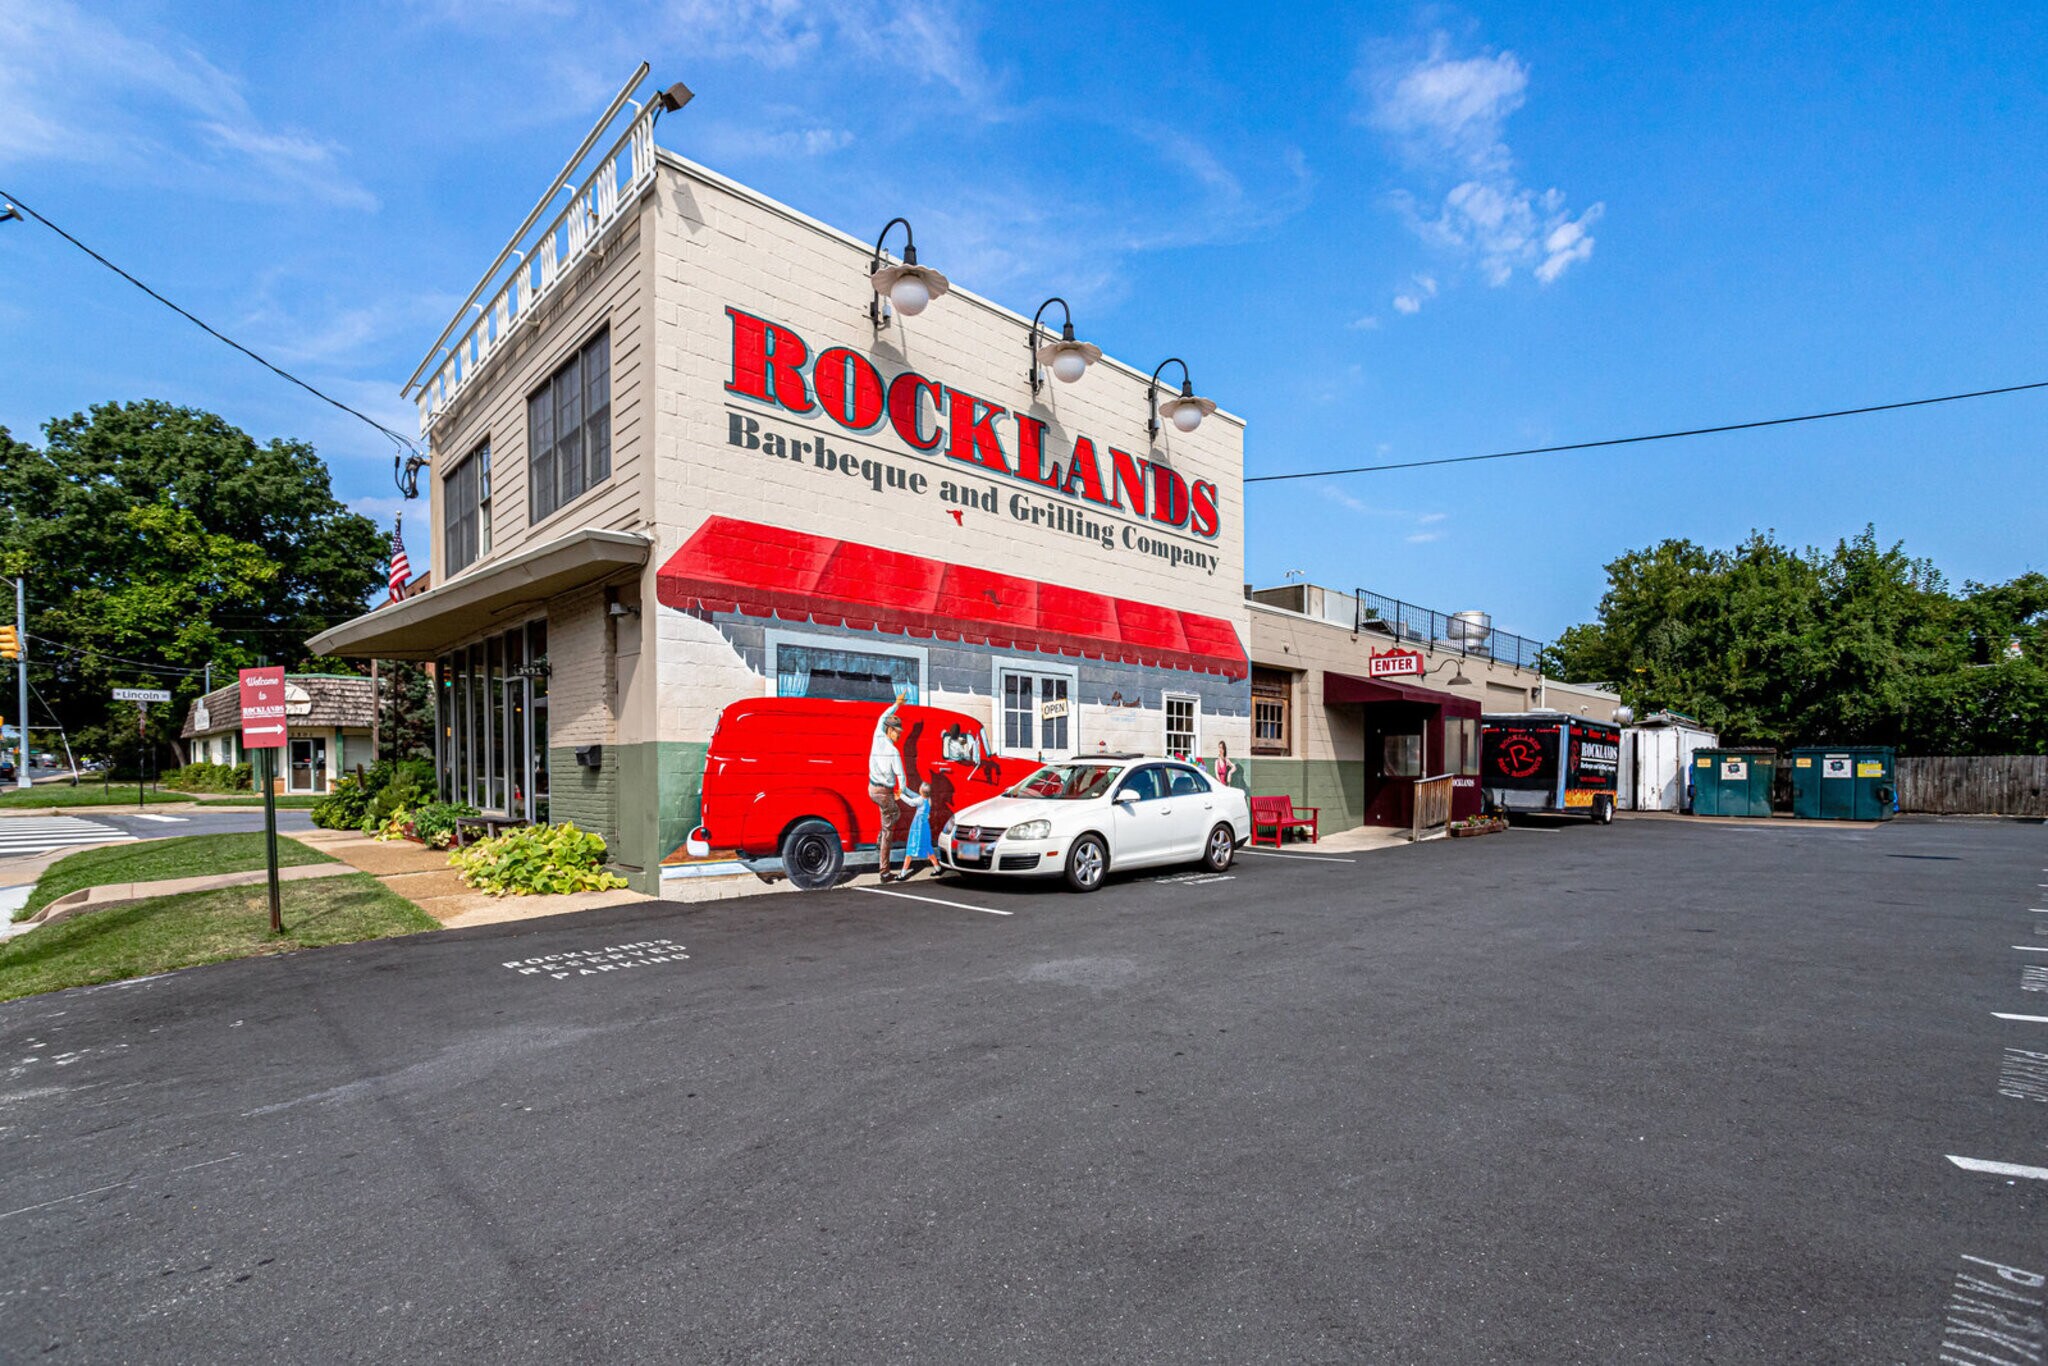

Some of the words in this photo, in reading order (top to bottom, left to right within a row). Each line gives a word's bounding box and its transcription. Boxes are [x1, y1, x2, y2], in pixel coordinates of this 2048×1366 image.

[724, 305, 1221, 540] ROCKLANDS
[725, 411, 928, 494] Barbeque
[939, 480, 999, 514] and
[1009, 493, 1115, 550] Grilling
[1121, 525, 1220, 576] Company
[1375, 658, 1412, 671] ENTER
[245, 676, 279, 687] Welcome
[122, 691, 160, 700] Lincoln
[258, 691, 267, 700] to
[242, 705, 285, 716] ROCKLANDS
[1044, 702, 1065, 715] OPEN
[1581, 742, 1617, 760] ROCKLANDS
[502, 938, 673, 969] ROCKLANDS
[551, 953, 691, 980] PARKING
[1939, 1253, 2047, 1366] PARKI
